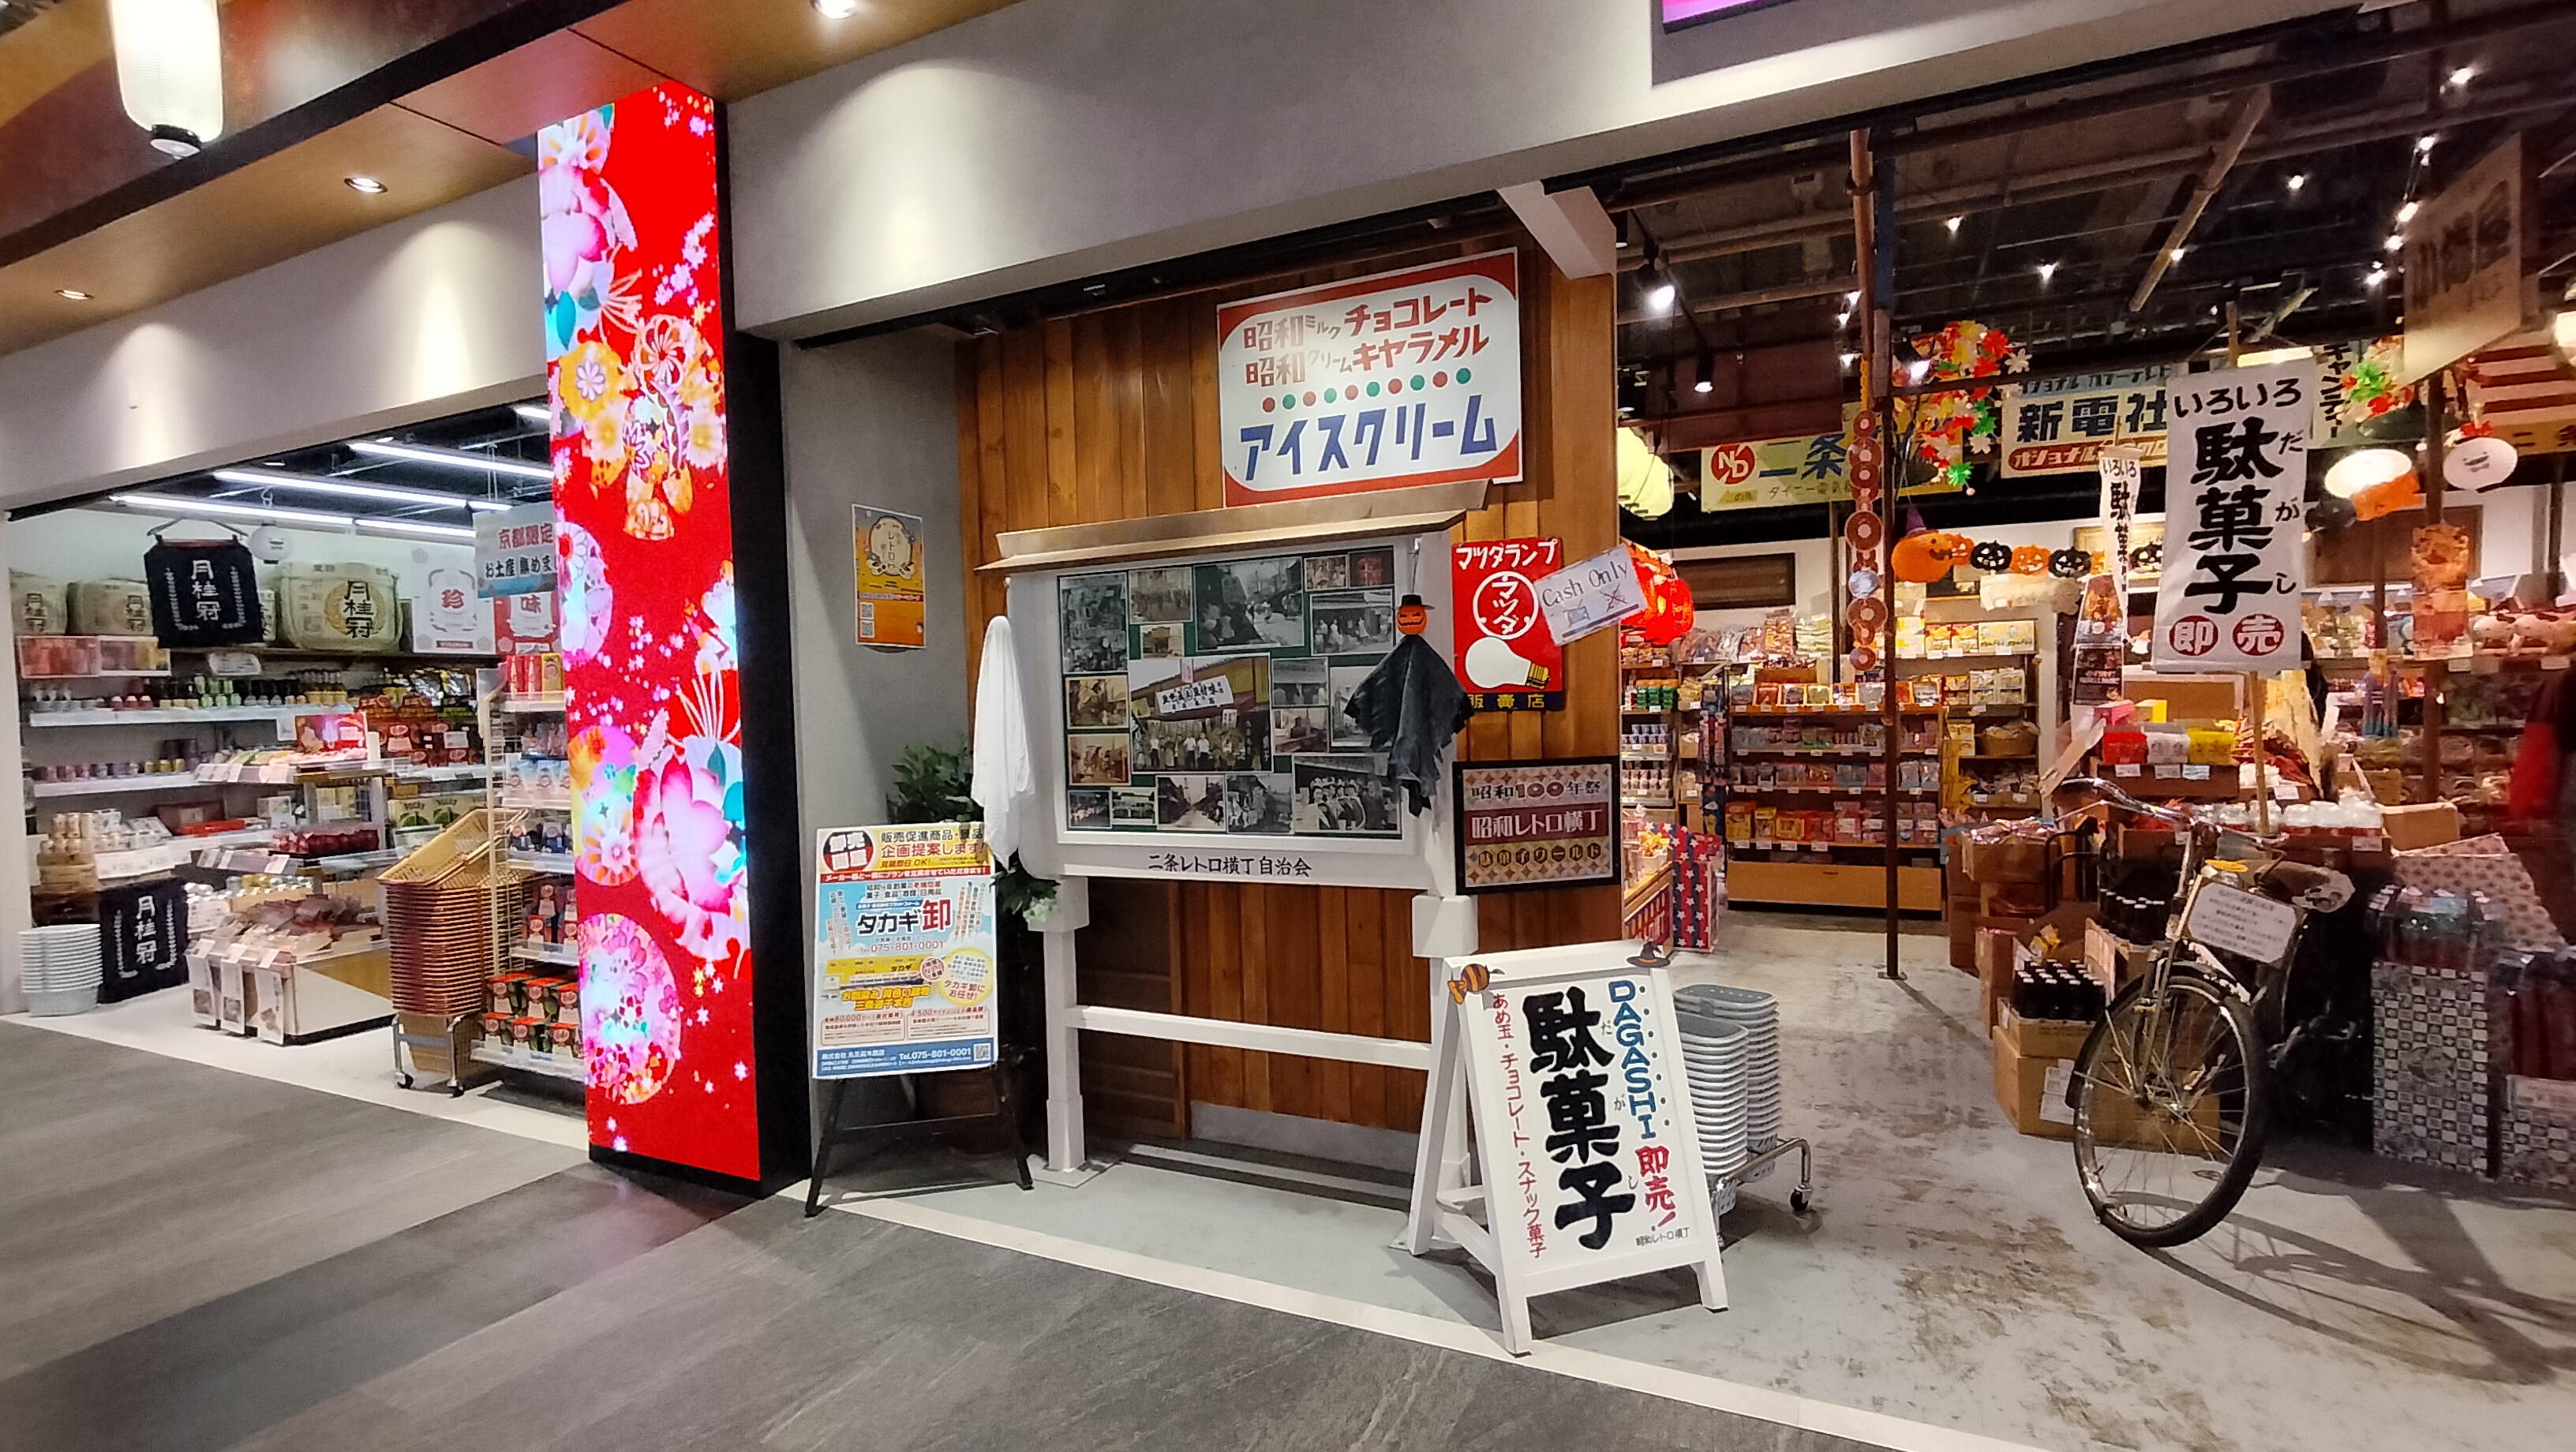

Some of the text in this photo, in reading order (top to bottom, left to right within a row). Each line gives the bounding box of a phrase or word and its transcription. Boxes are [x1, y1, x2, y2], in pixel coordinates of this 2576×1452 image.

[2016, 389, 2167, 443] 新電社
[2174, 378, 2302, 418] いろいろ
[1240, 395, 1497, 481] アイスクリーム
[2185, 417, 2284, 615] 駄菓子
[1456, 537, 1559, 571] マツダランプ
[190, 559, 222, 621] 月桂冠
[343, 580, 375, 639] 月桂冠
[1492, 582, 1519, 635] マツダ
[1541, 560, 1629, 608] Cash Only
[1471, 780, 1601, 799] 昭和100年祭
[1471, 809, 1603, 839] 昭和レトロ横丁
[134, 895, 157, 964] 月桂冠
[858, 899, 951, 934] タカギ卸
[871, 940, 943, 952] 075-801-0001
[1608, 980, 1656, 1140] DAGASHI
[1522, 986, 1636, 1250] 駄菓子
